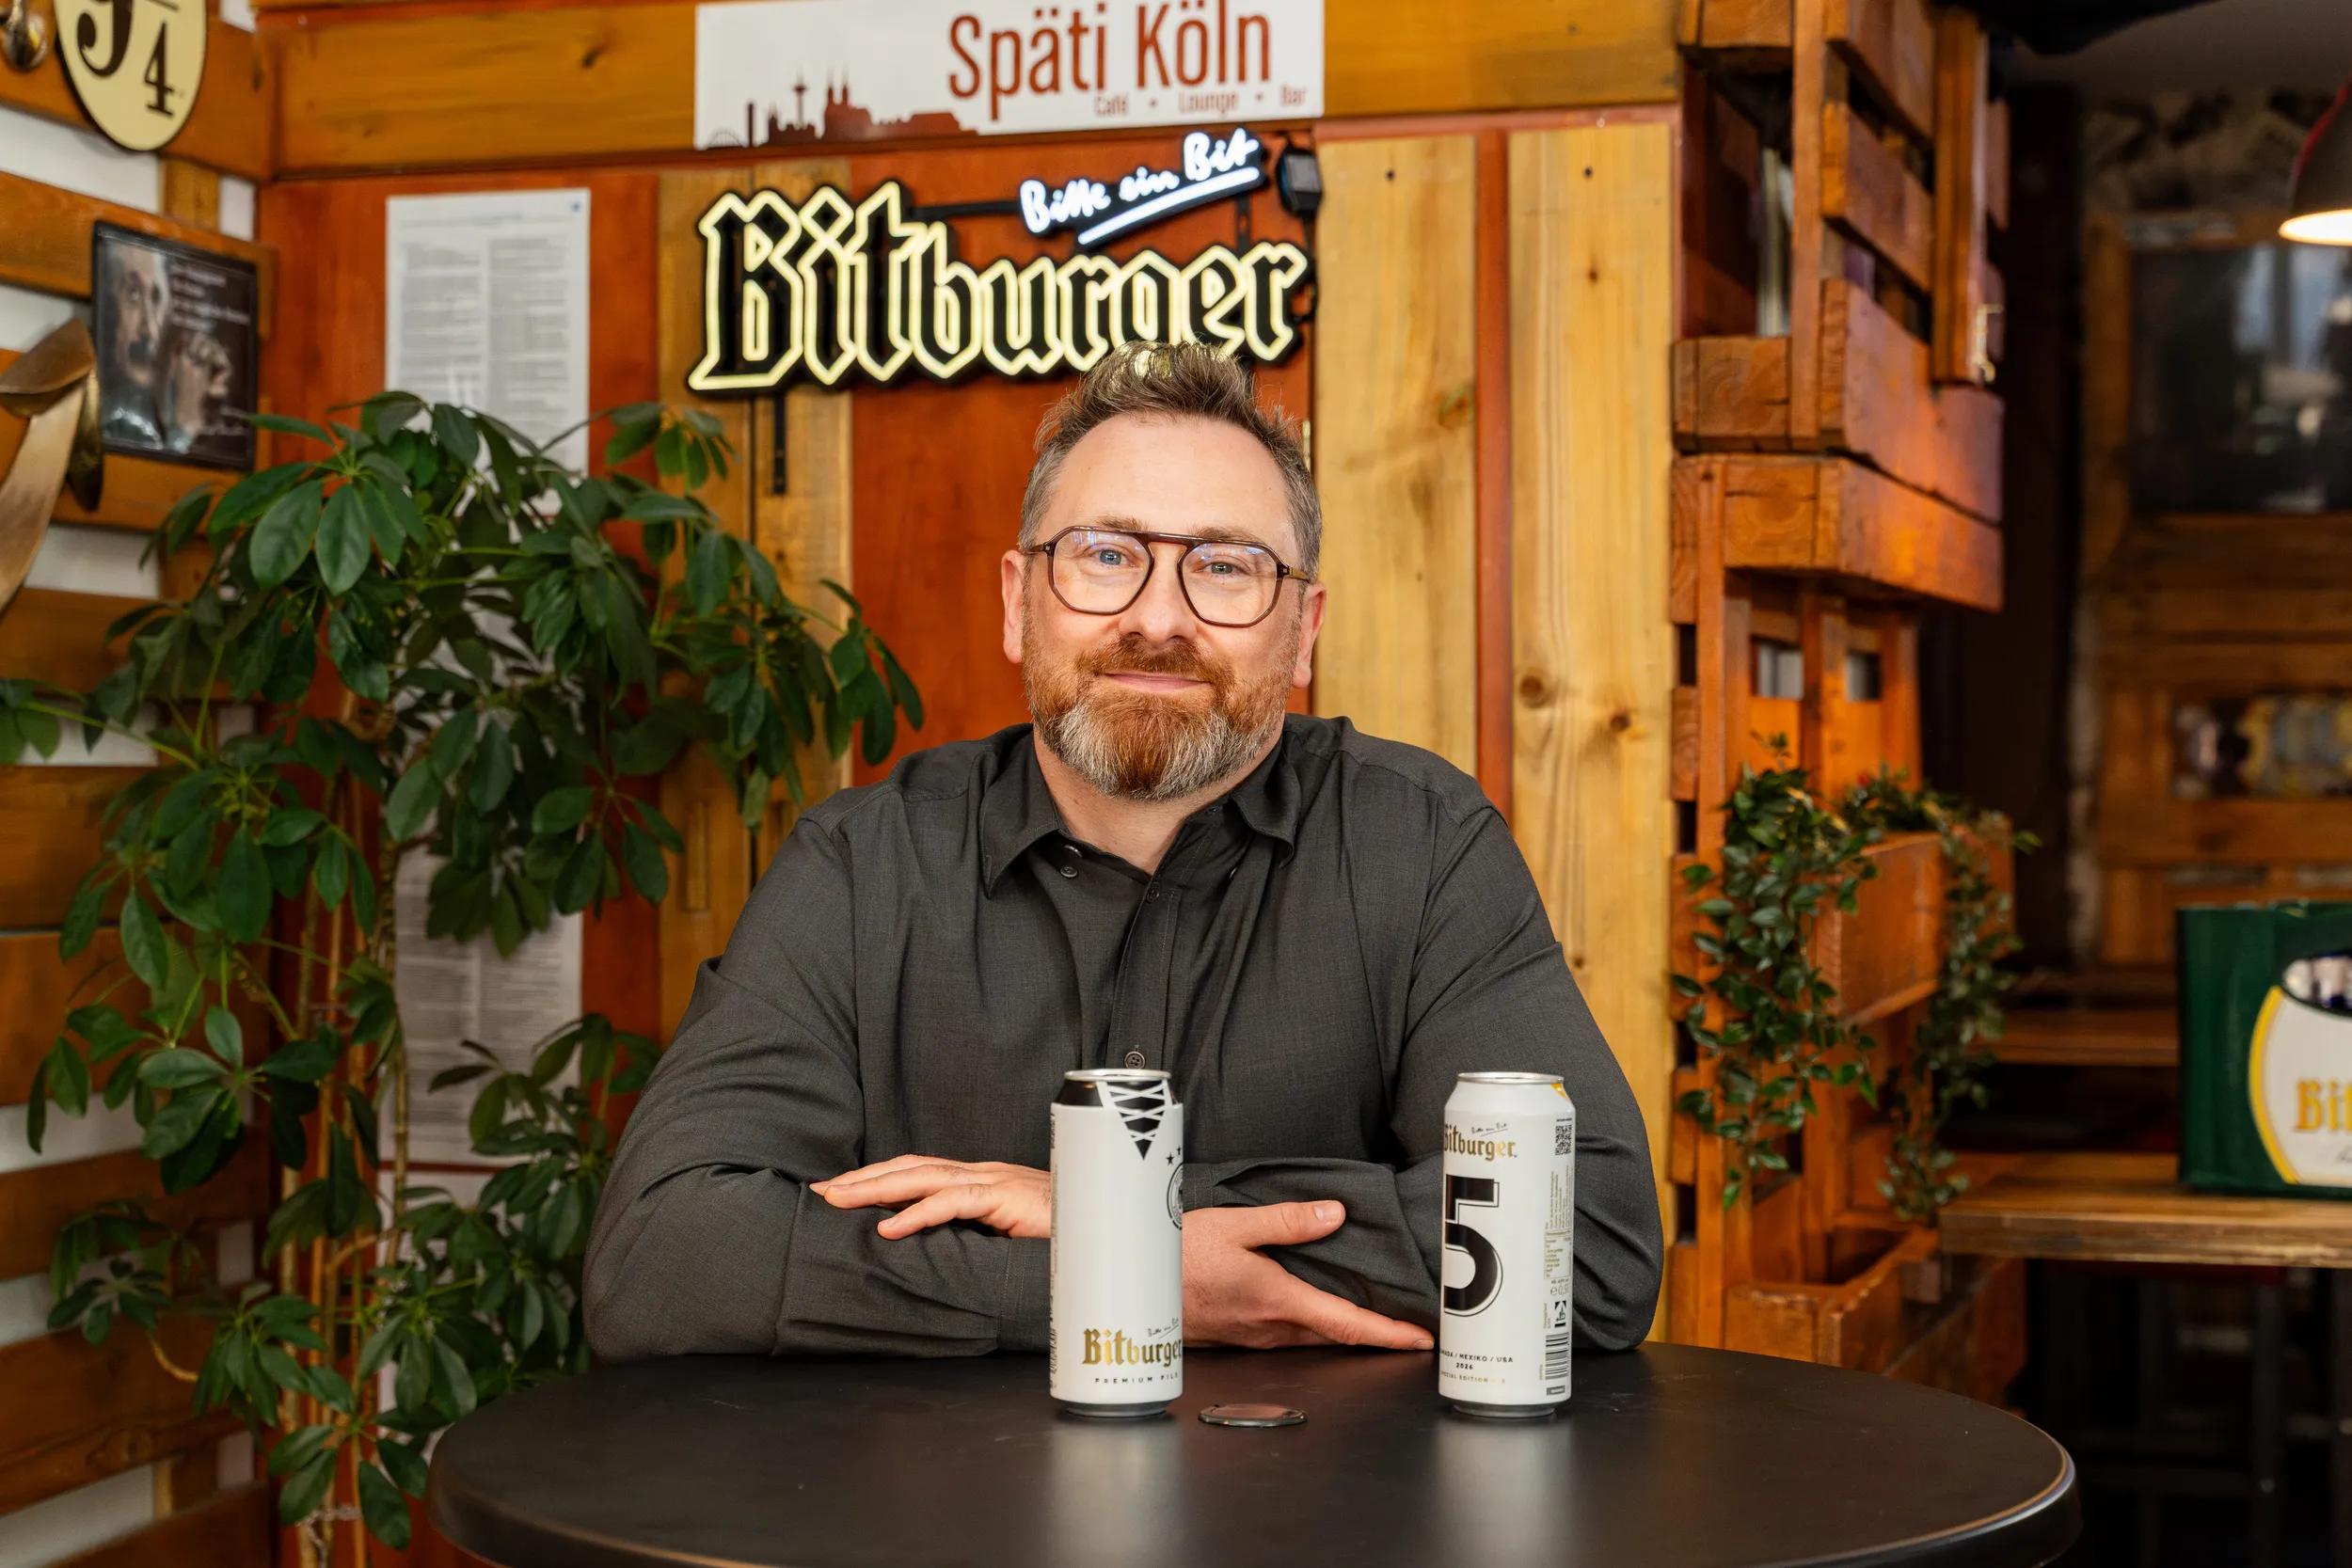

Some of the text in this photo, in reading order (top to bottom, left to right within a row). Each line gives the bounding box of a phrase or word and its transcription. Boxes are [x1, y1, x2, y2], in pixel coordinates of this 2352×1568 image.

[948, 0, 1270, 121] Späti Köln
[1094, 85, 1307, 117] Café Lounge Bar
[1019, 127, 1261, 233] Bitte ein Bit
[688, 182, 1309, 391] Bitburger
[1443, 1173, 1503, 1318] 5
[1081, 1328, 1182, 1369] Bitburger
[1459, 1354, 1487, 1362] MEXIKO
